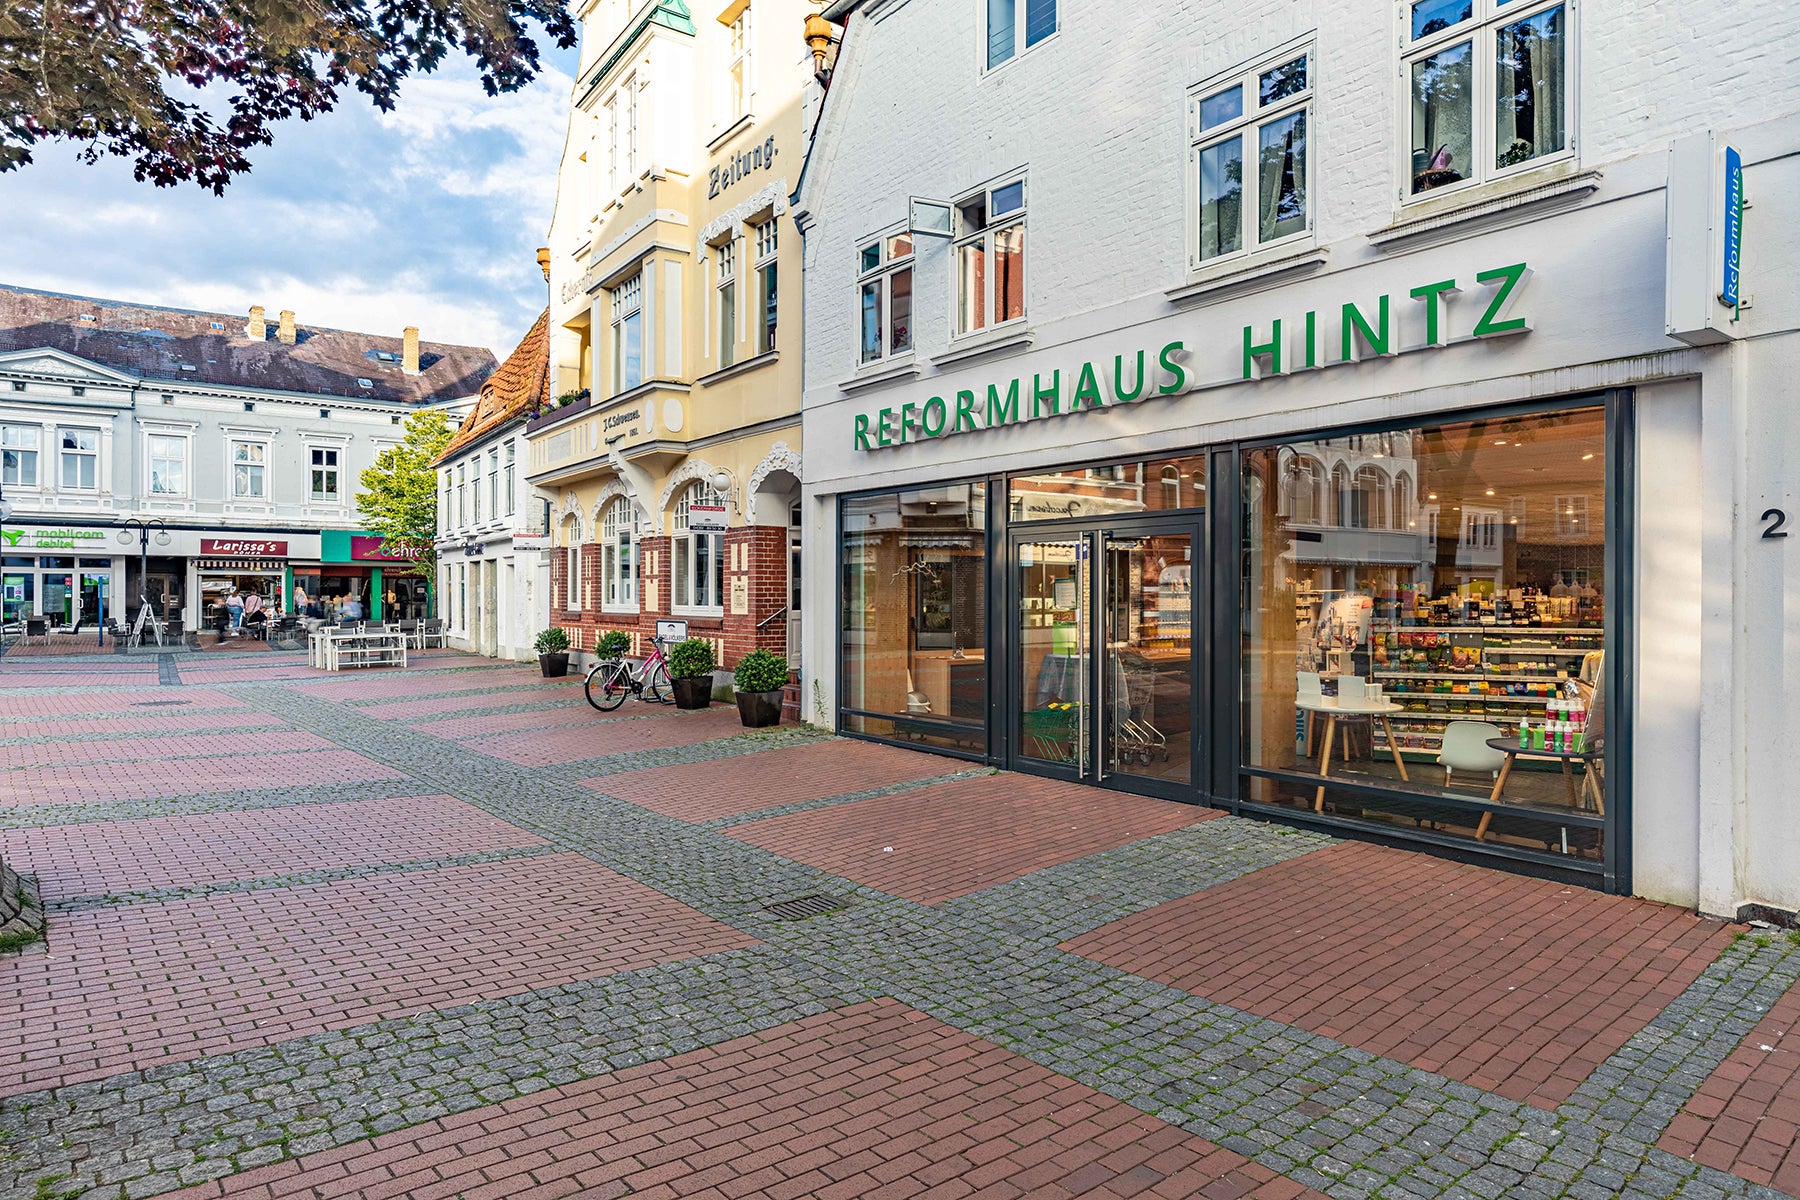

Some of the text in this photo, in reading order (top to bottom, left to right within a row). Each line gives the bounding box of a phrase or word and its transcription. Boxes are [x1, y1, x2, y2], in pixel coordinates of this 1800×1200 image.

[708, 135, 779, 201] Zeitung.
[1728, 166, 1740, 299] Reformhaus
[855, 262, 1532, 452] REFORMHAUS HINTZ
[36, 529, 105, 539] mobilcom
[36, 539, 75, 549] debitel
[1761, 508, 1788, 539] 2
